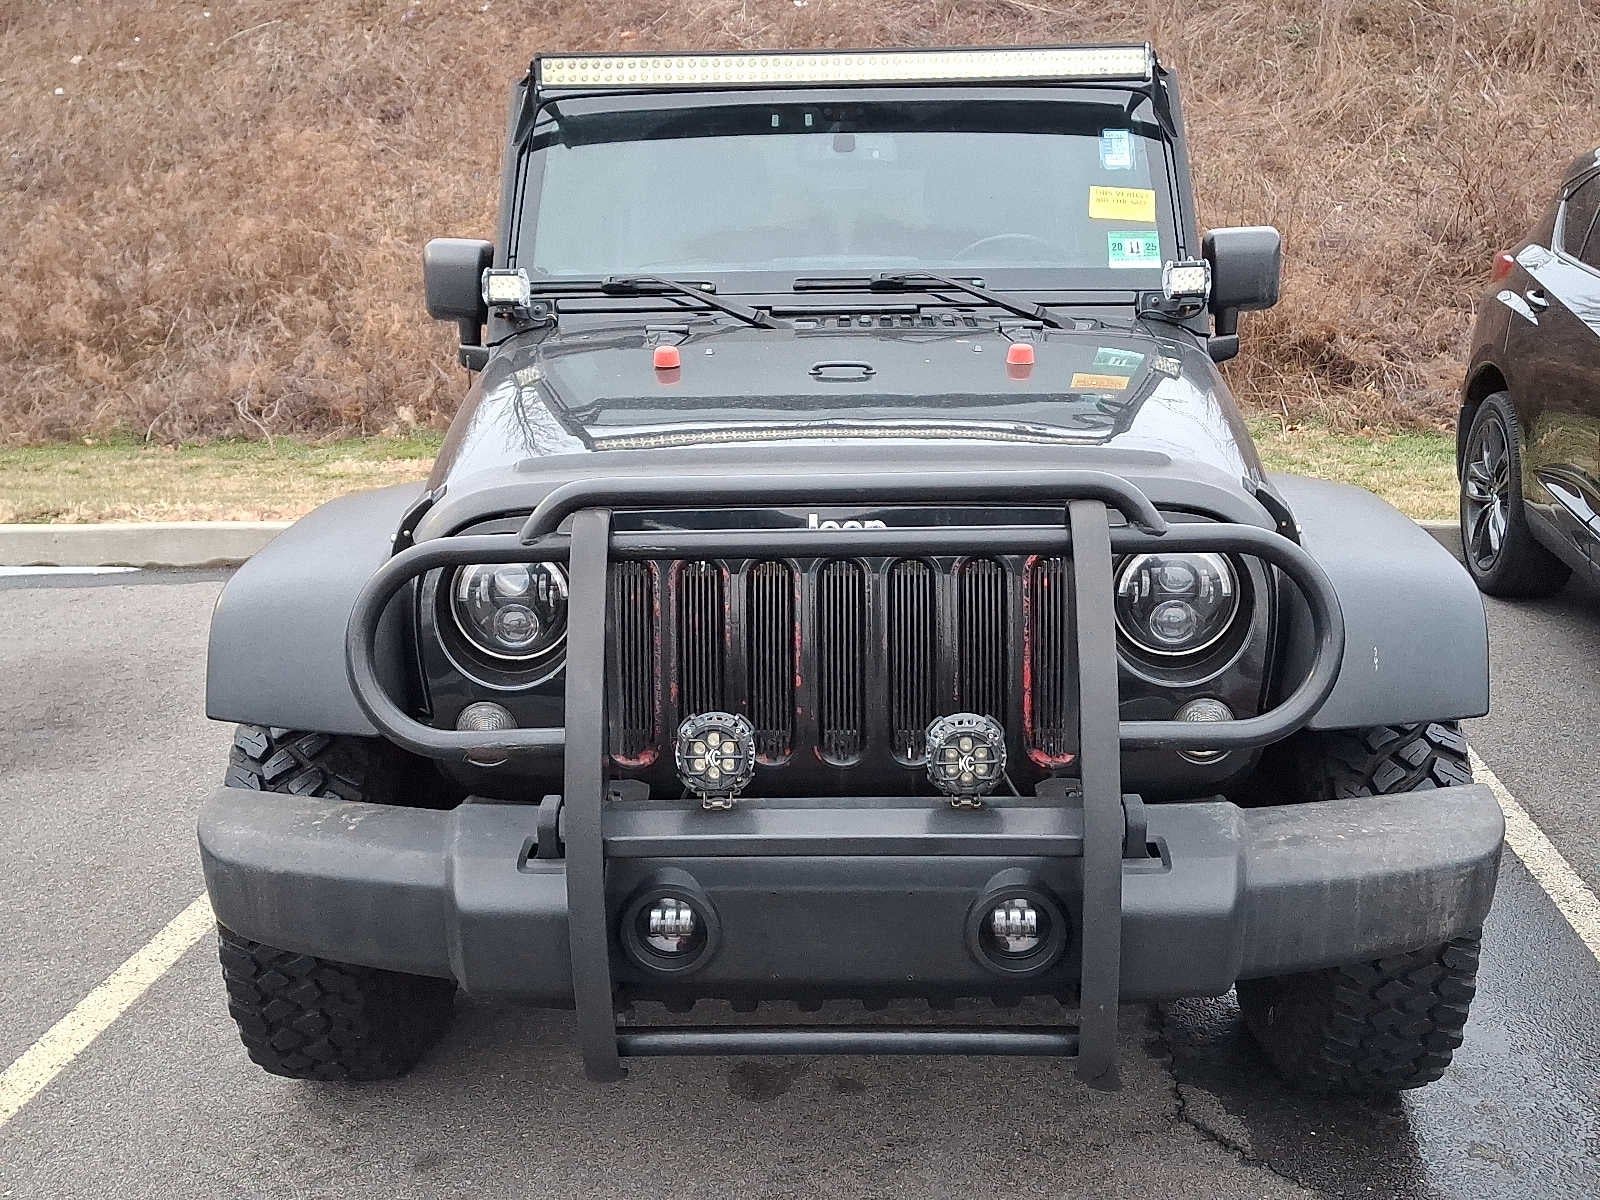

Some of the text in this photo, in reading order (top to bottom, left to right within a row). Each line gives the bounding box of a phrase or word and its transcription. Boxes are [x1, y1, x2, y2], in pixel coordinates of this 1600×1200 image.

[1112, 241, 1157, 254] 20 11 25
[705, 748, 721, 767] KC
[959, 755, 975, 772] KC
